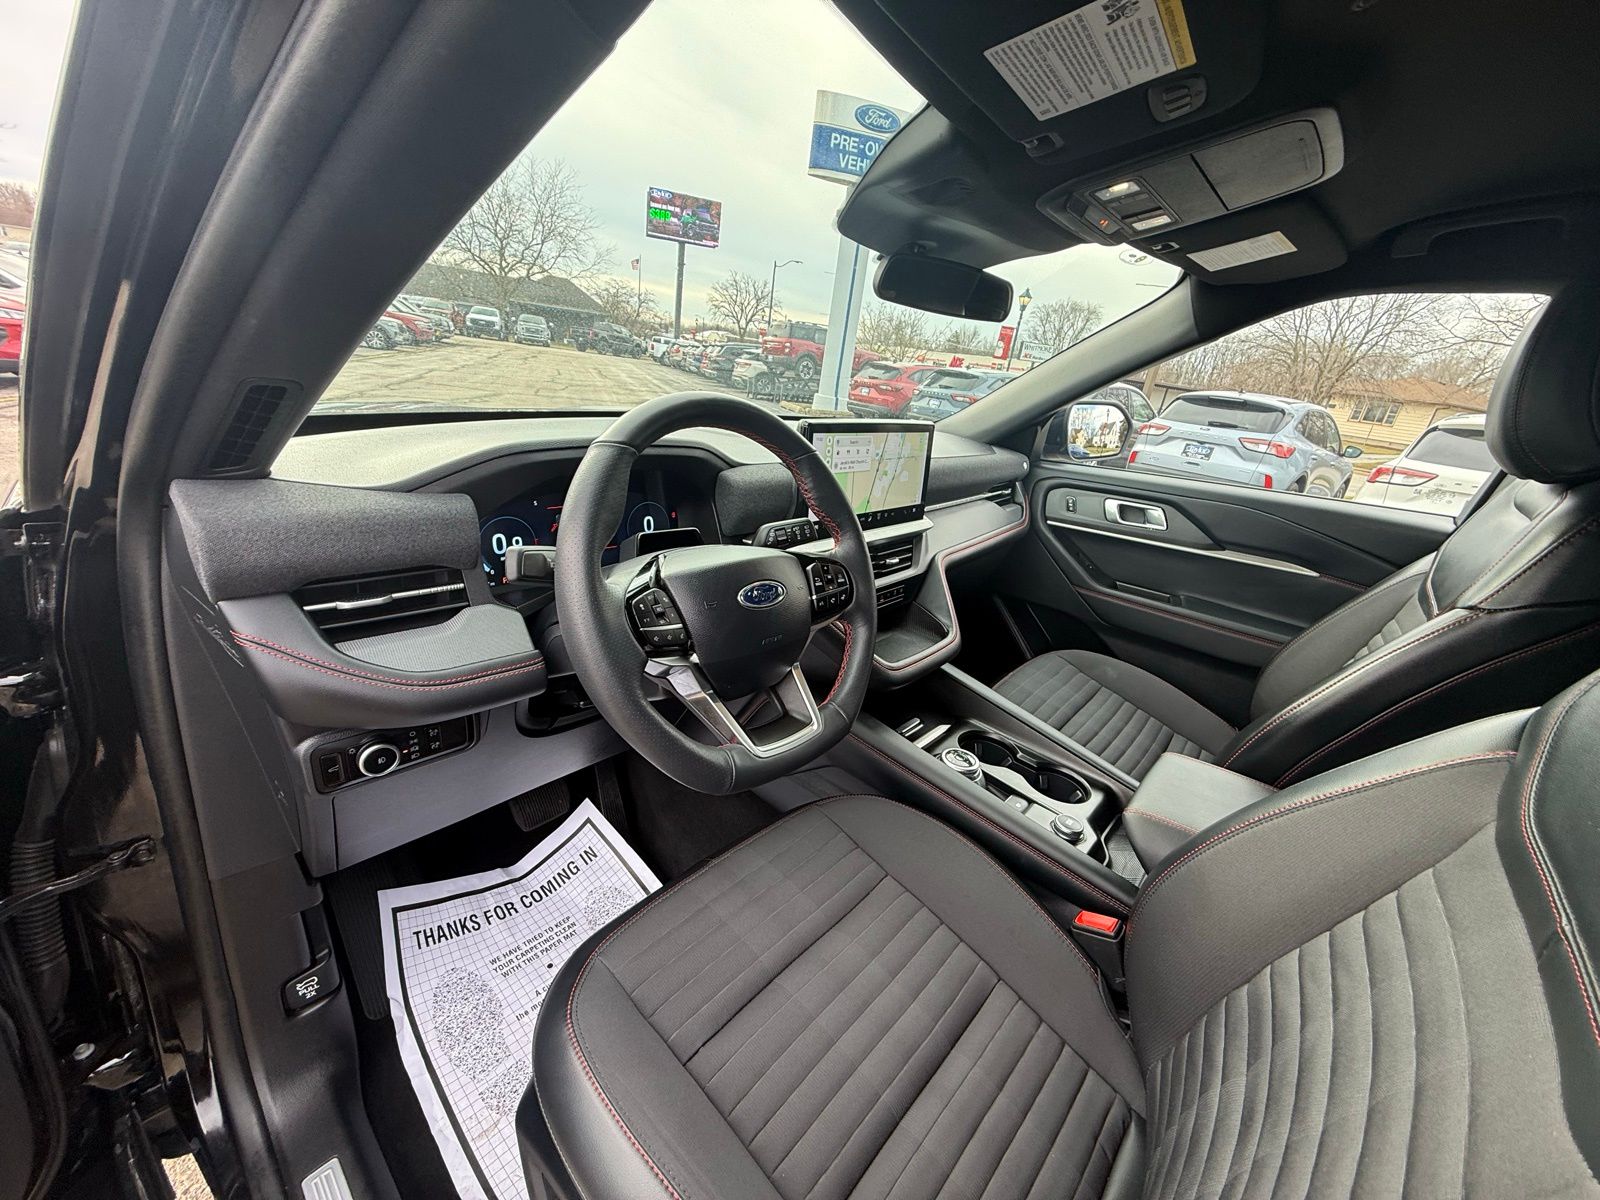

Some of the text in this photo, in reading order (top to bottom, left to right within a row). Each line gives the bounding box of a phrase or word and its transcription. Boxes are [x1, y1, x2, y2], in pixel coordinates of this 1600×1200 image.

[864, 108, 892, 129] Ford
[643, 515, 655, 533] 0
[413, 846, 598, 949] THANKS FOR COMING IN
[489, 916, 571, 966] WE HAVE TRIED TO KEEP
[493, 921, 577, 974] YOUR CARPETING CLEAN
[501, 929, 578, 978] WITH THIS PAPER MAT
[298, 984, 320, 996] PULL
[305, 990, 317, 999] 2X
[535, 989, 541, 997] A
[515, 1010, 530, 1021] the
